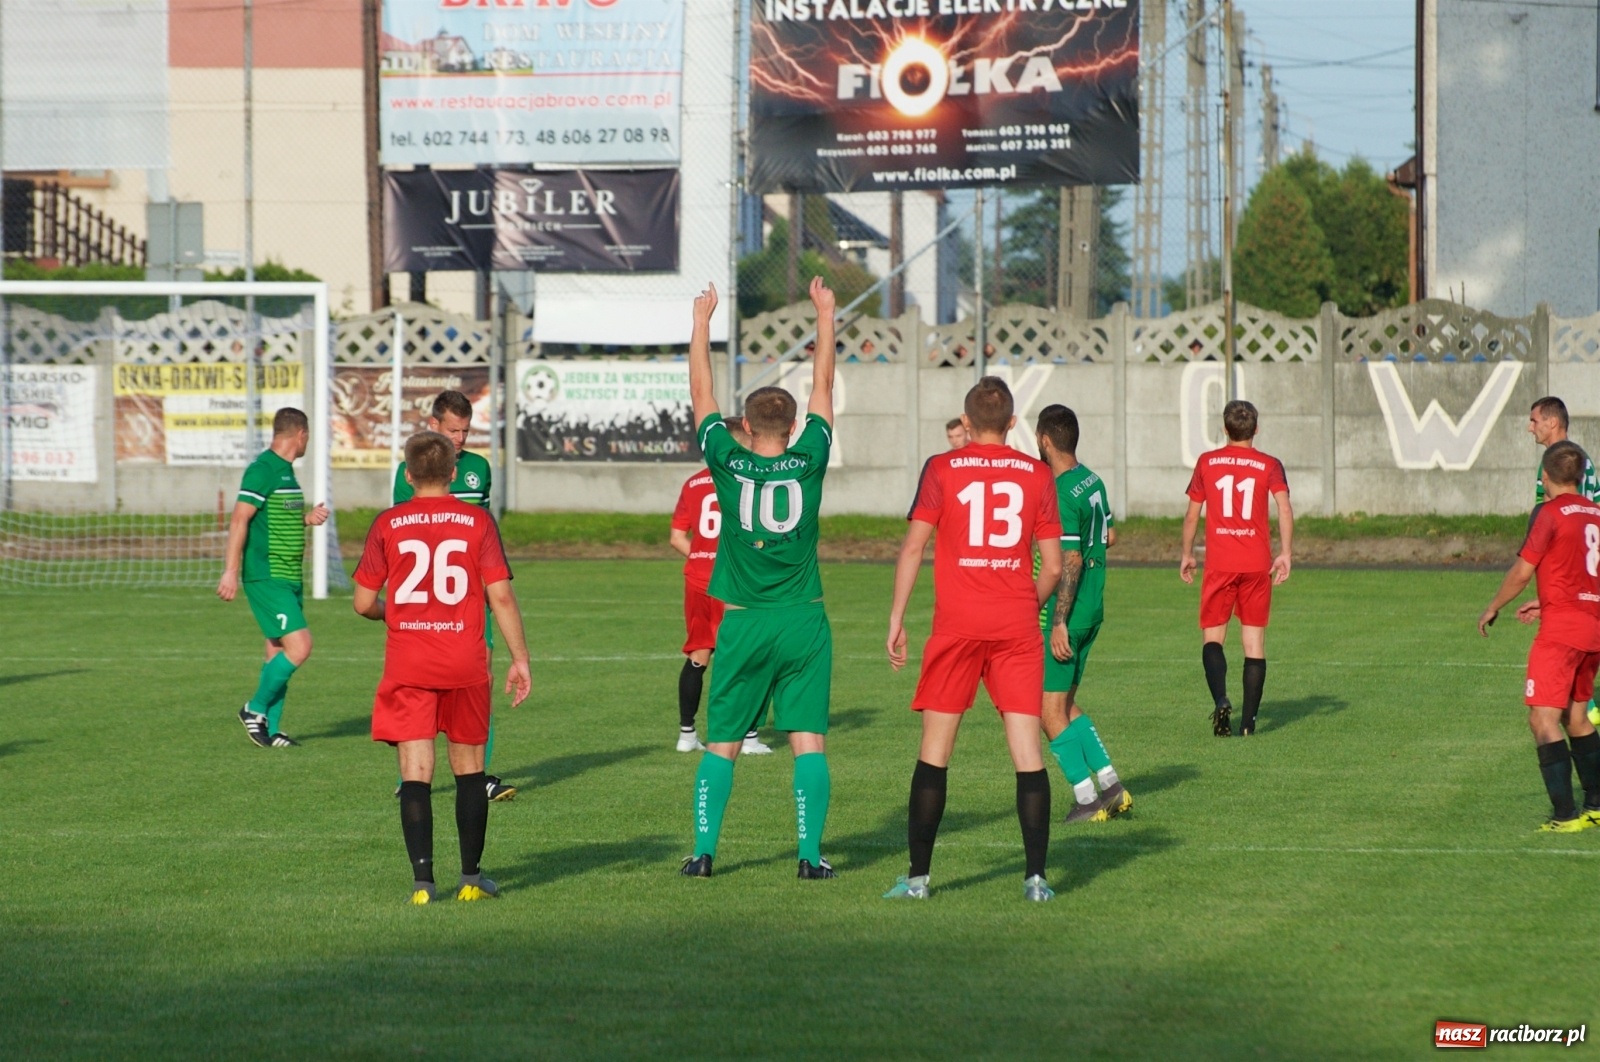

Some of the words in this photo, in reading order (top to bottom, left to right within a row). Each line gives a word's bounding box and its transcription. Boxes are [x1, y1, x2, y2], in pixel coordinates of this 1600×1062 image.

[765, 0, 931, 21] INSTALACJE
[483, 22, 541, 42] DOM
[555, 22, 670, 42] WESELNY
[483, 49, 673, 70] RESTAURACJA
[390, 91, 672, 112] www.restauracjabravo.com.pl
[422, 130, 453, 147] 602
[459, 130, 488, 146] 744
[536, 129, 556, 145] 48
[561, 128, 592, 145] 606
[598, 128, 618, 144] 27
[623, 127, 643, 144] 08
[650, 127, 670, 143] 98
[872, 163, 1017, 183] www.fiolka.com.pl
[118, 366, 300, 390] OKNA-DRZWI-SHODY
[562, 371, 599, 385] JEDEN
[603, 372, 618, 384] ZA
[622, 371, 690, 384] WSZYSTKIC
[565, 388, 619, 400] WSZYSCY
[623, 389, 637, 400] ZA
[950, 457, 990, 469] GRANICA
[991, 458, 1034, 473] RUPTAWA
[733, 474, 804, 534] 10
[1214, 474, 1256, 521] 11
[390, 512, 430, 529] GRANICA
[431, 512, 475, 528] RUPTAWA
[698, 492, 723, 540] 6
[956, 481, 1024, 549] 13
[1584, 523, 1600, 577] 8
[394, 538, 469, 606] 26
[958, 557, 1022, 571] maxima-sport.pl
[276, 613, 288, 630] 7
[400, 619, 464, 633] maxima-sport.pl
[1526, 678, 1535, 698] 8
